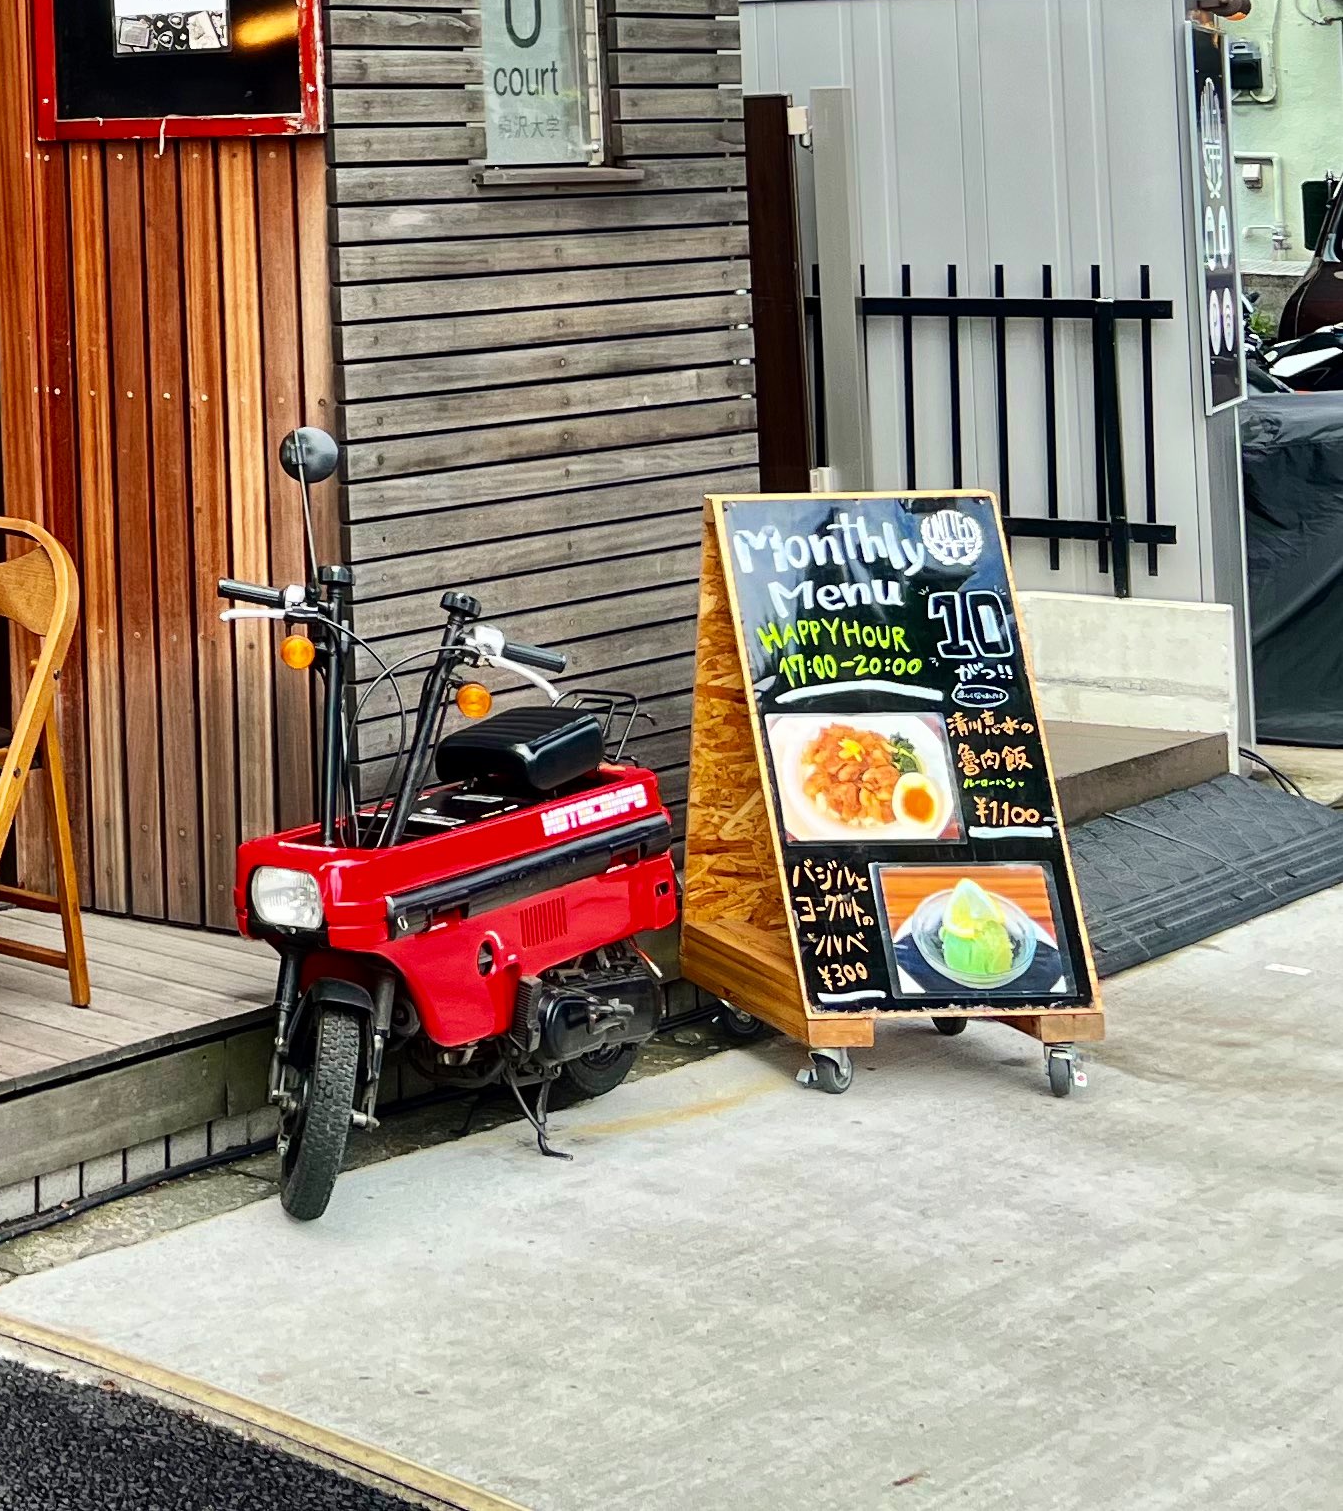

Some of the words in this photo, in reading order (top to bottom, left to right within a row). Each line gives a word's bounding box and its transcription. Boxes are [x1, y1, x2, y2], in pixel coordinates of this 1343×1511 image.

[493, 60, 559, 96] court
[734, 512, 927, 577] Monthly
[767, 578, 906, 619] Menu
[928, 589, 1015, 659] 10
[792, 858, 869, 893] バジルと
[795, 895, 874, 928] ヨーグルトの
[817, 961, 869, 992] ¥300
